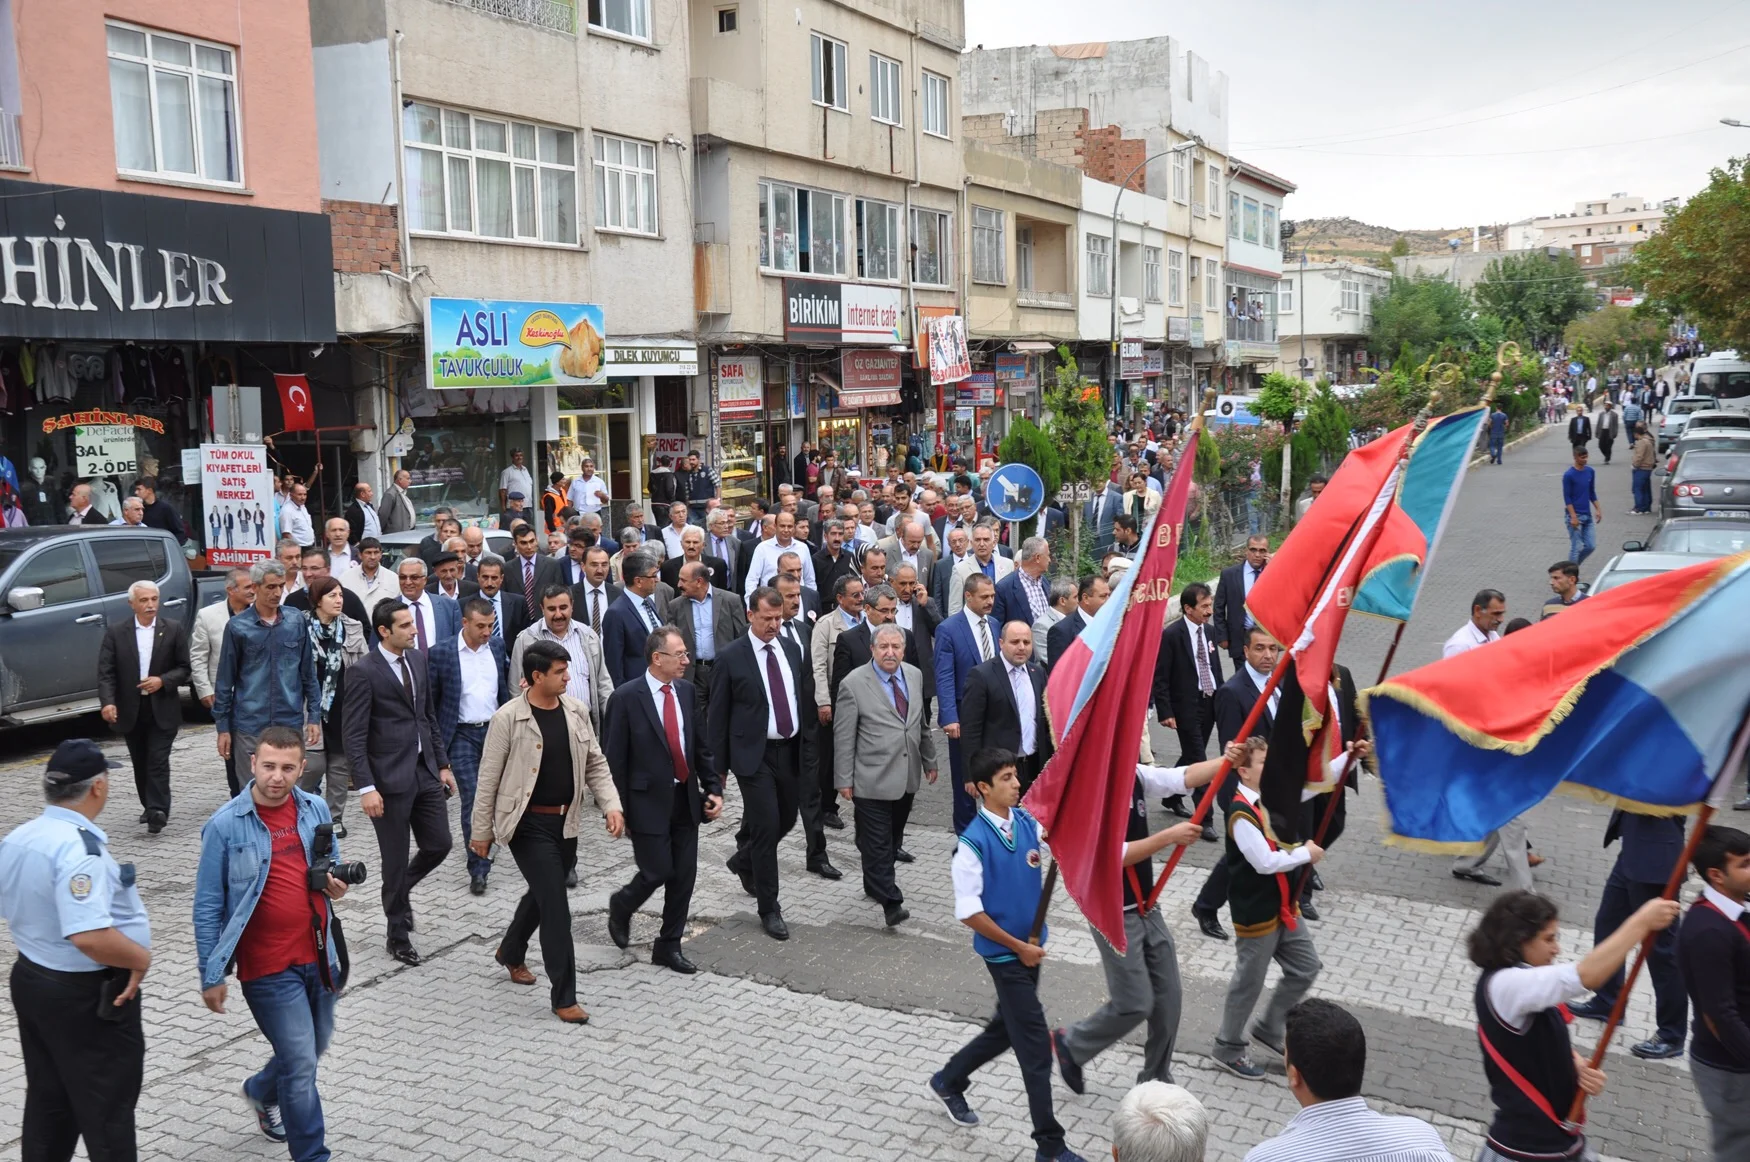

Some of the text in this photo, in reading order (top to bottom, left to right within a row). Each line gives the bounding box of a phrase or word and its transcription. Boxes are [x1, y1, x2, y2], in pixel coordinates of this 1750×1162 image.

[789, 293, 897, 328] BİRİKİM internet cafe
[456, 309, 508, 347] ASLI
[525, 327, 564, 339] Keskinoğlu
[614, 350, 681, 362] DİLEK KUYUMCU
[865, 356, 898, 370] GAZİANTEP
[439, 357, 524, 380] TAVUKÇULUK
[721, 364, 743, 378] SAFA
[43, 407, 164, 434] ŞAHİNLER
[210, 451, 255, 460] TÜM OKUL
[206, 463, 262, 474] KIYAFETLERİ
[221, 477, 247, 488] SATIŞ
[216, 490, 254, 500] MERKEZİ
[316, 929, 324, 950] Canon
